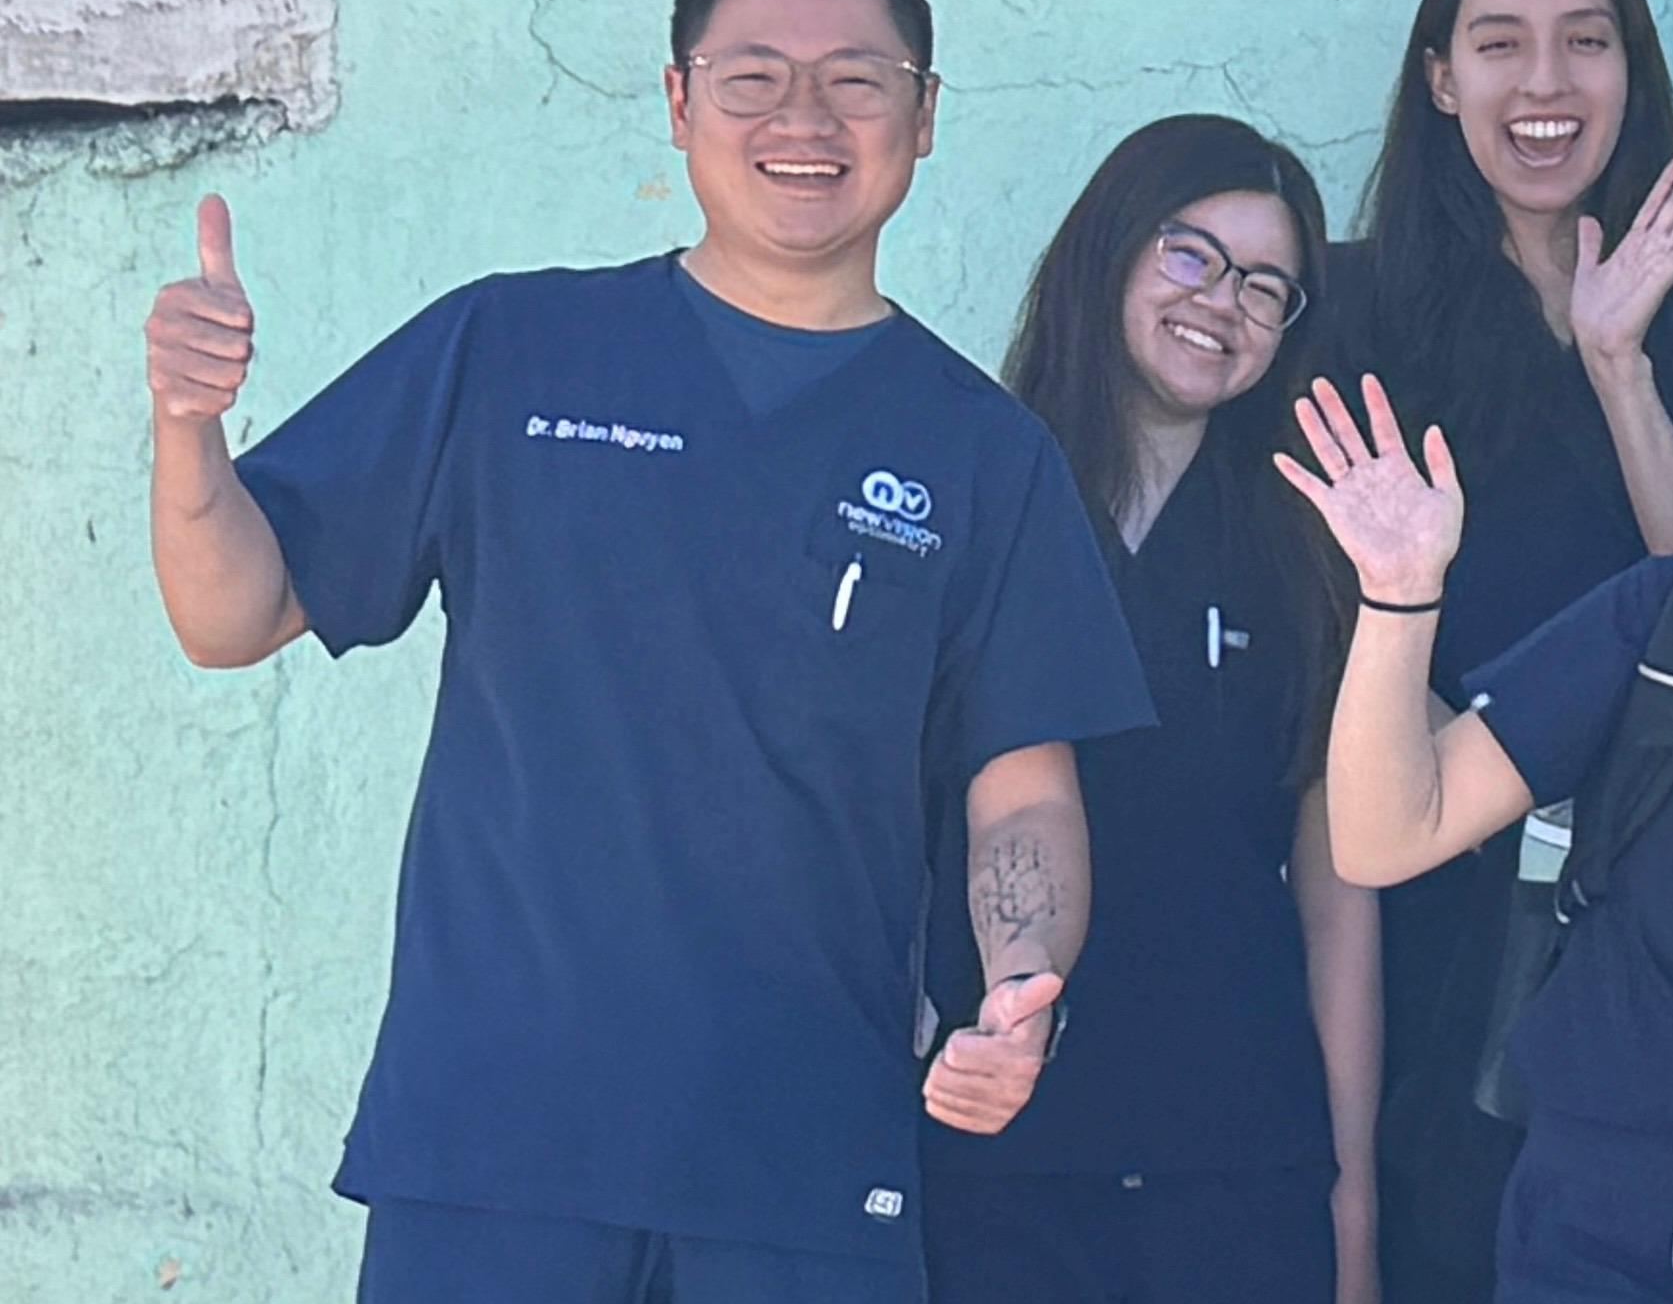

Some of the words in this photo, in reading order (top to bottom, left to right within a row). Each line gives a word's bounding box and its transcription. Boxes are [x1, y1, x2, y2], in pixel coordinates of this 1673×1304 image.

[526, 414, 552, 437] Dr.
[554, 418, 609, 442] Brian
[609, 423, 684, 452] Nguyen
